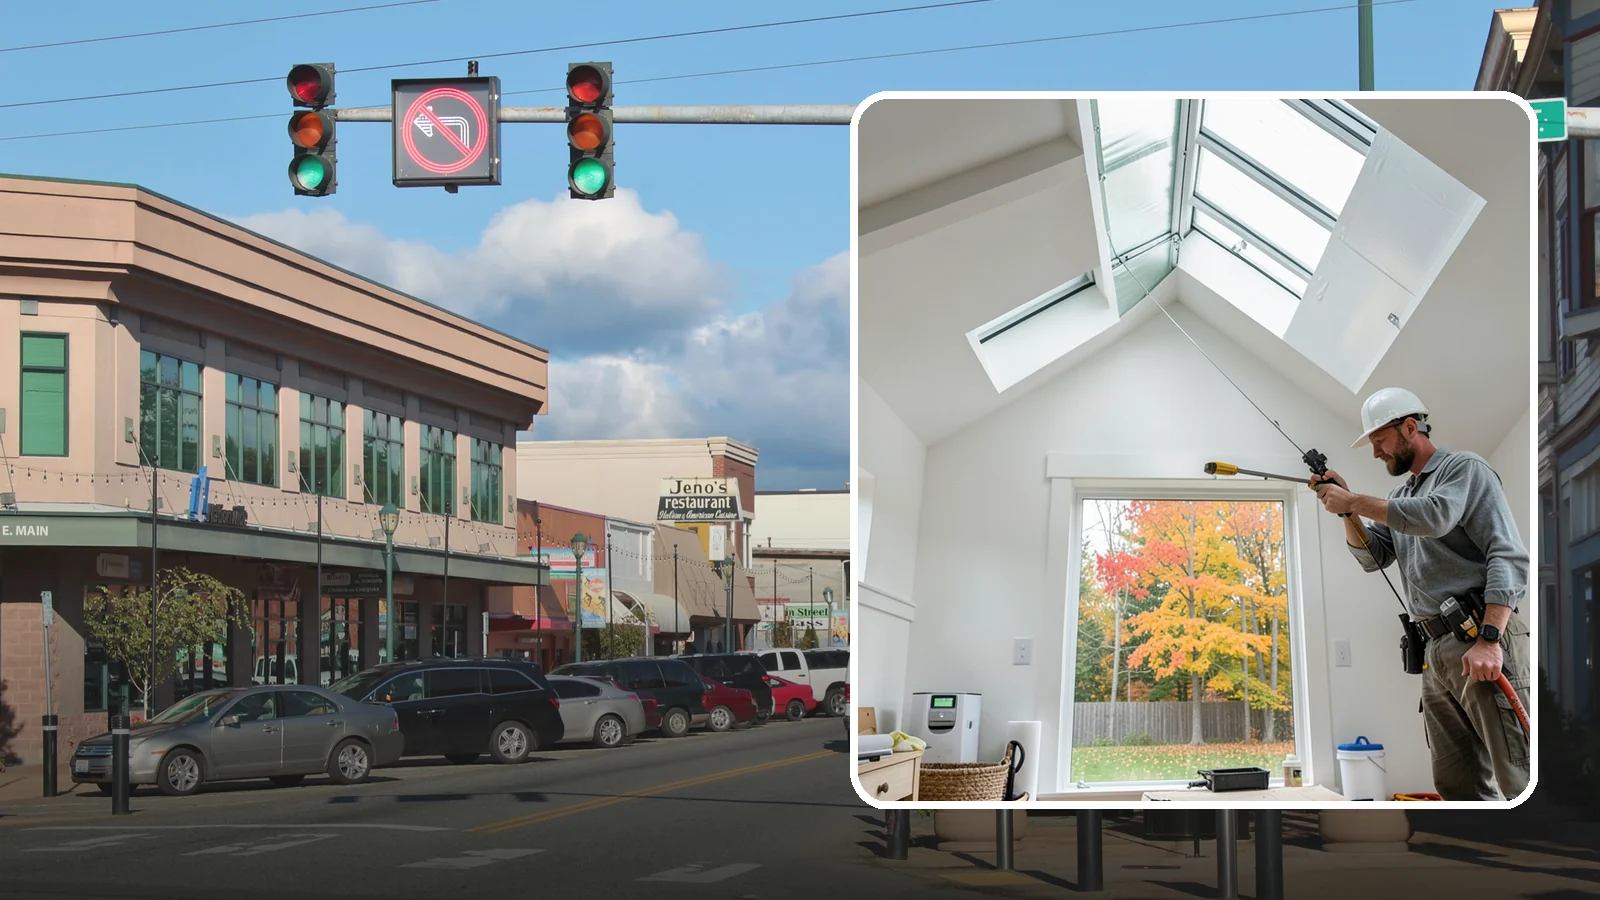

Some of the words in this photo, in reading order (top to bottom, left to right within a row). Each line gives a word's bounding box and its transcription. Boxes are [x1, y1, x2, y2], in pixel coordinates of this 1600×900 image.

[669, 479, 727, 495] Jeno's
[665, 496, 731, 509] restaurant
[658, 509, 681, 519] Italian
[686, 509, 715, 519] American
[715, 509, 738, 518] Cuisine
[2, 525, 13, 536] E.
[15, 525, 49, 536] MAIN
[797, 607, 829, 617] Street
